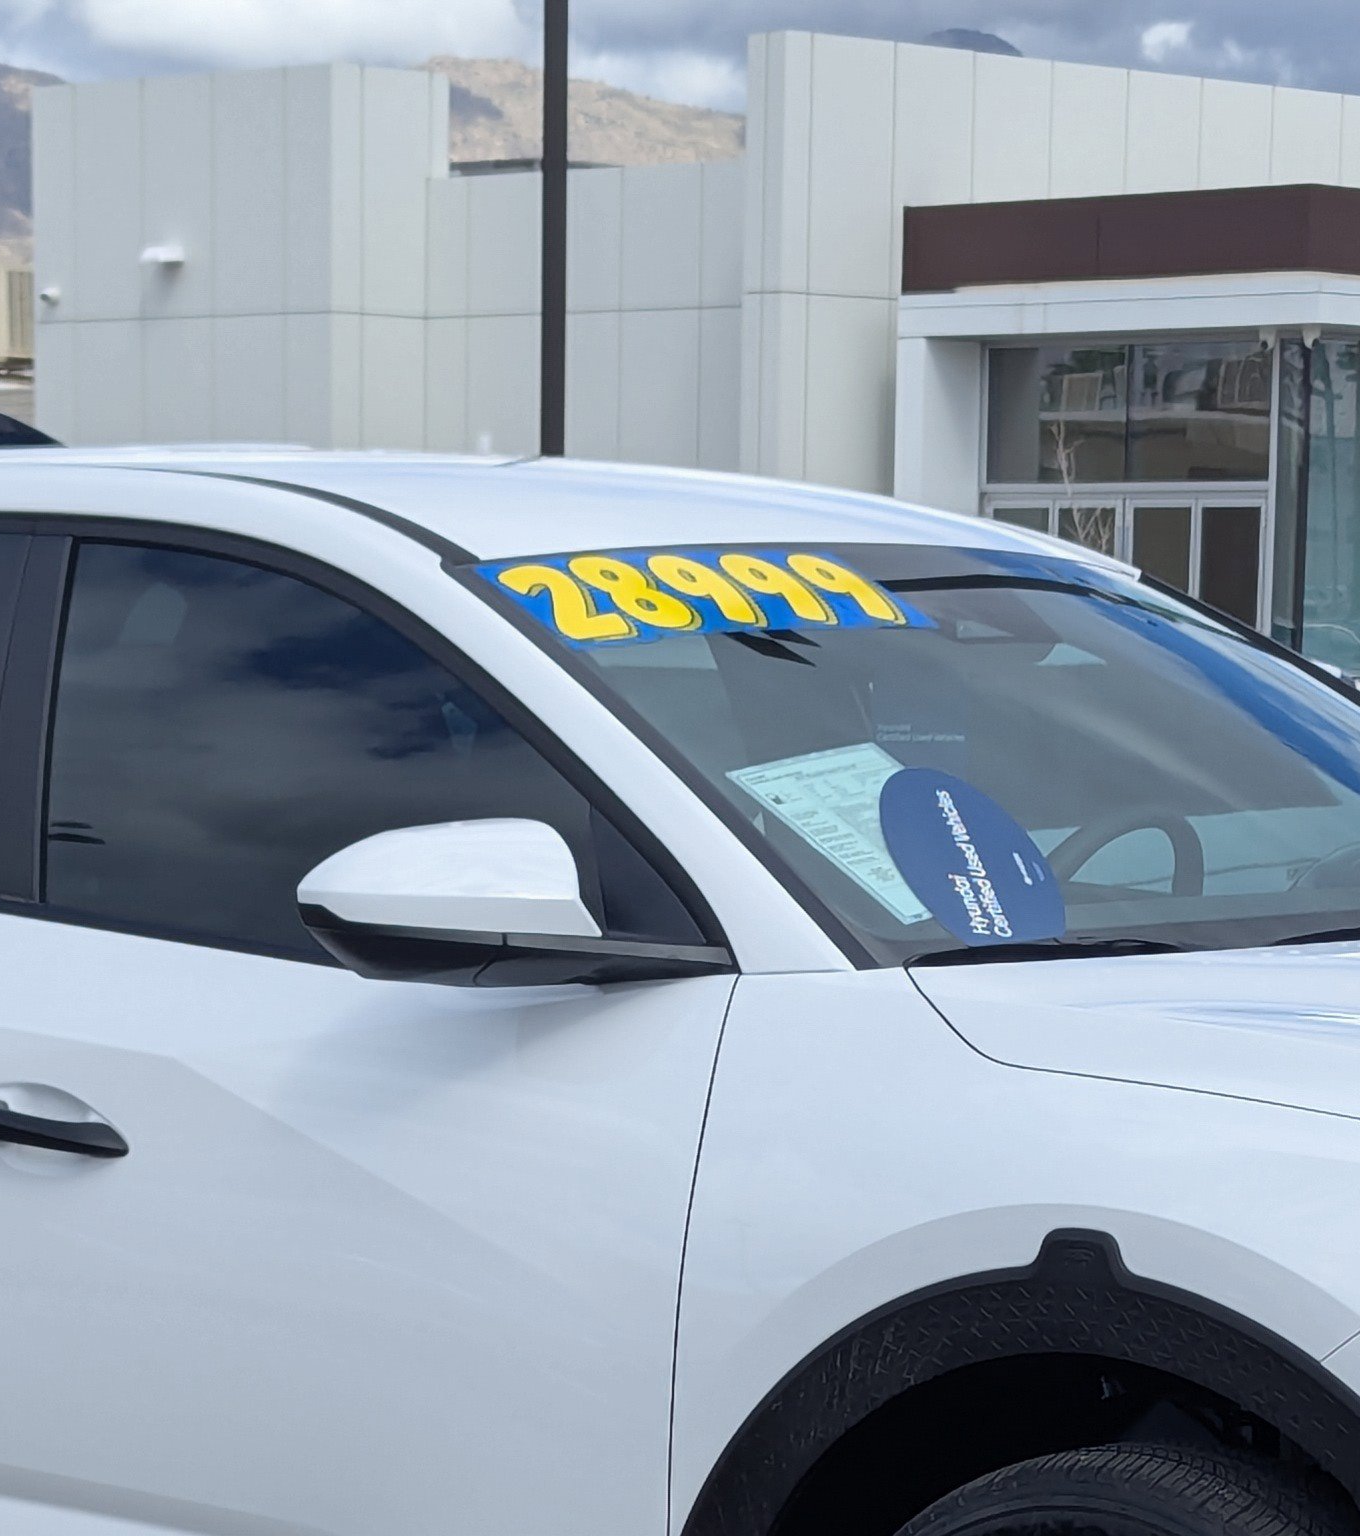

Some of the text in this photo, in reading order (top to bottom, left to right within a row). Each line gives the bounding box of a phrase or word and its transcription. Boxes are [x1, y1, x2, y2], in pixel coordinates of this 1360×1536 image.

[497, 553, 907, 642] 28999
[936, 789, 1013, 938] Certified Used Vehicles
[947, 874, 991, 935] Hyundai
